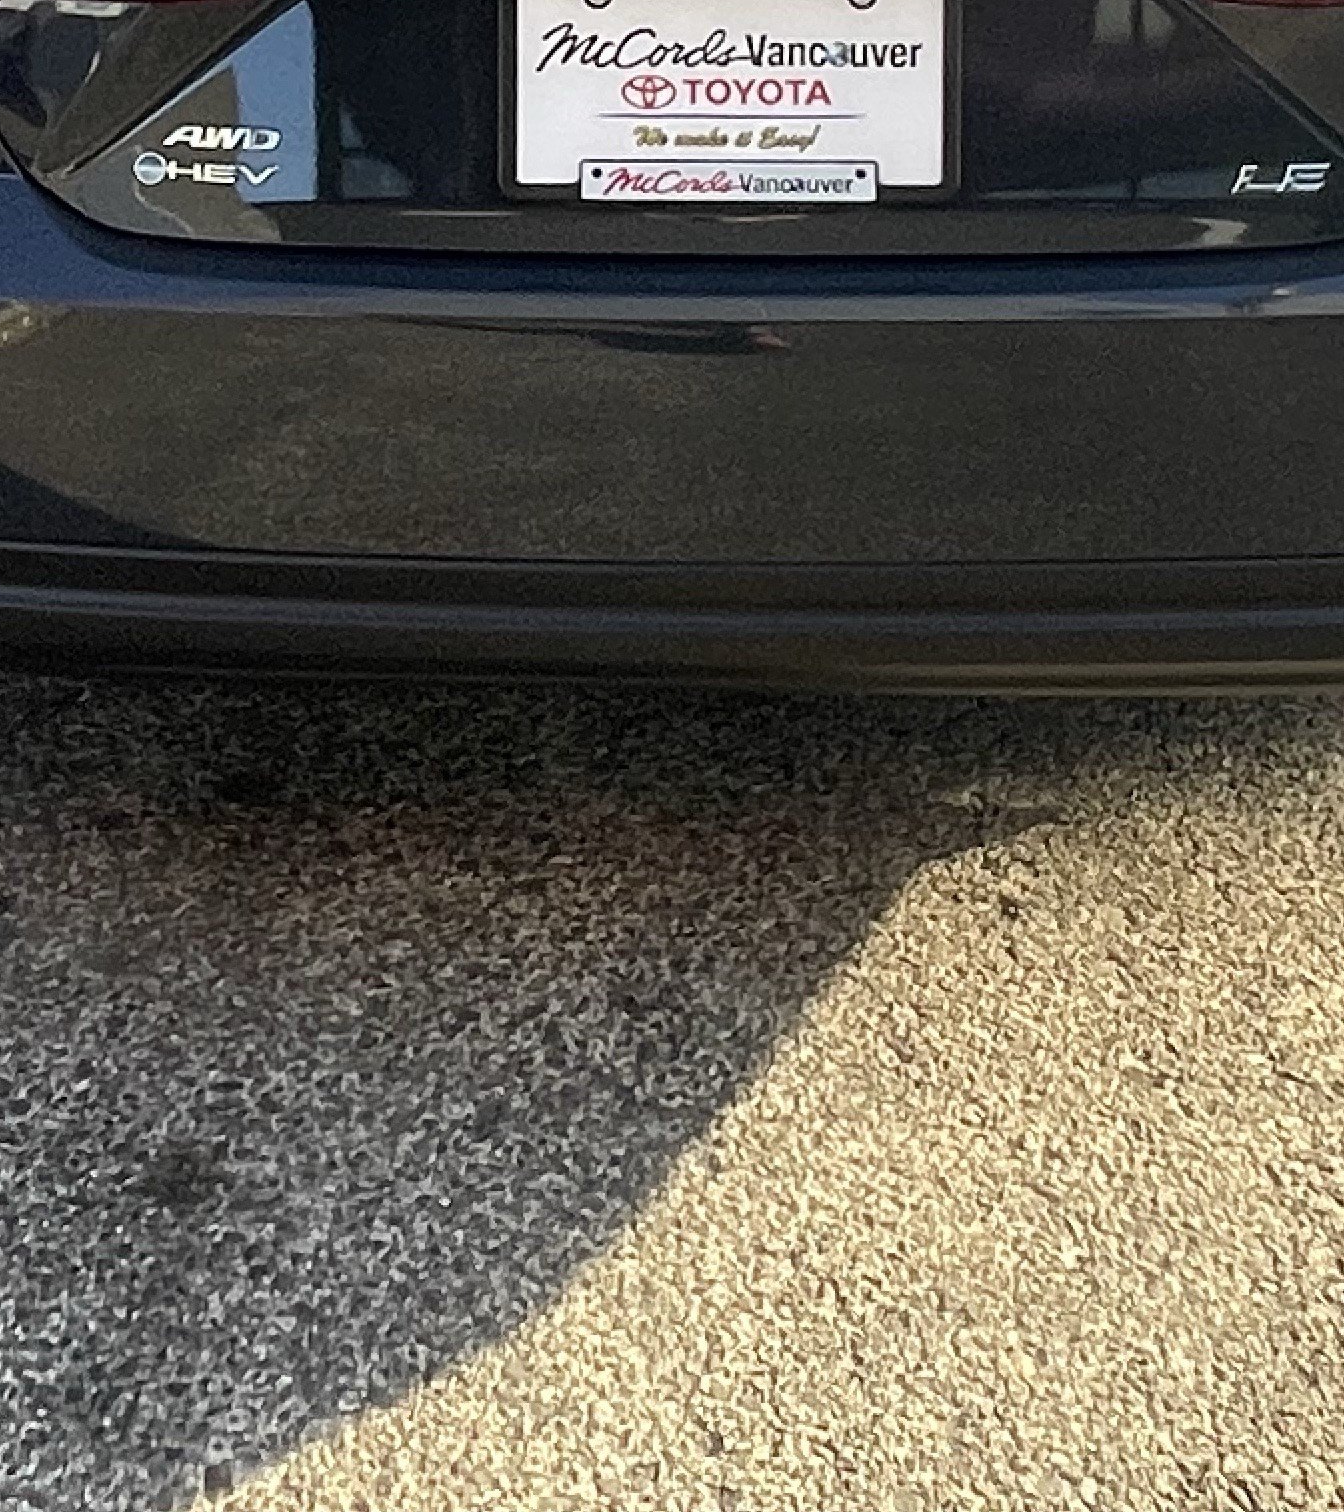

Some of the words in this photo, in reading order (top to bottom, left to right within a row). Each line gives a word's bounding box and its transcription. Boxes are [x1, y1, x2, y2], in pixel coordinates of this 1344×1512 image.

[682, 78, 832, 106] TOYOTA
[162, 124, 281, 150] AWD
[167, 160, 280, 185] HEV
[1230, 162, 1332, 195] LE
